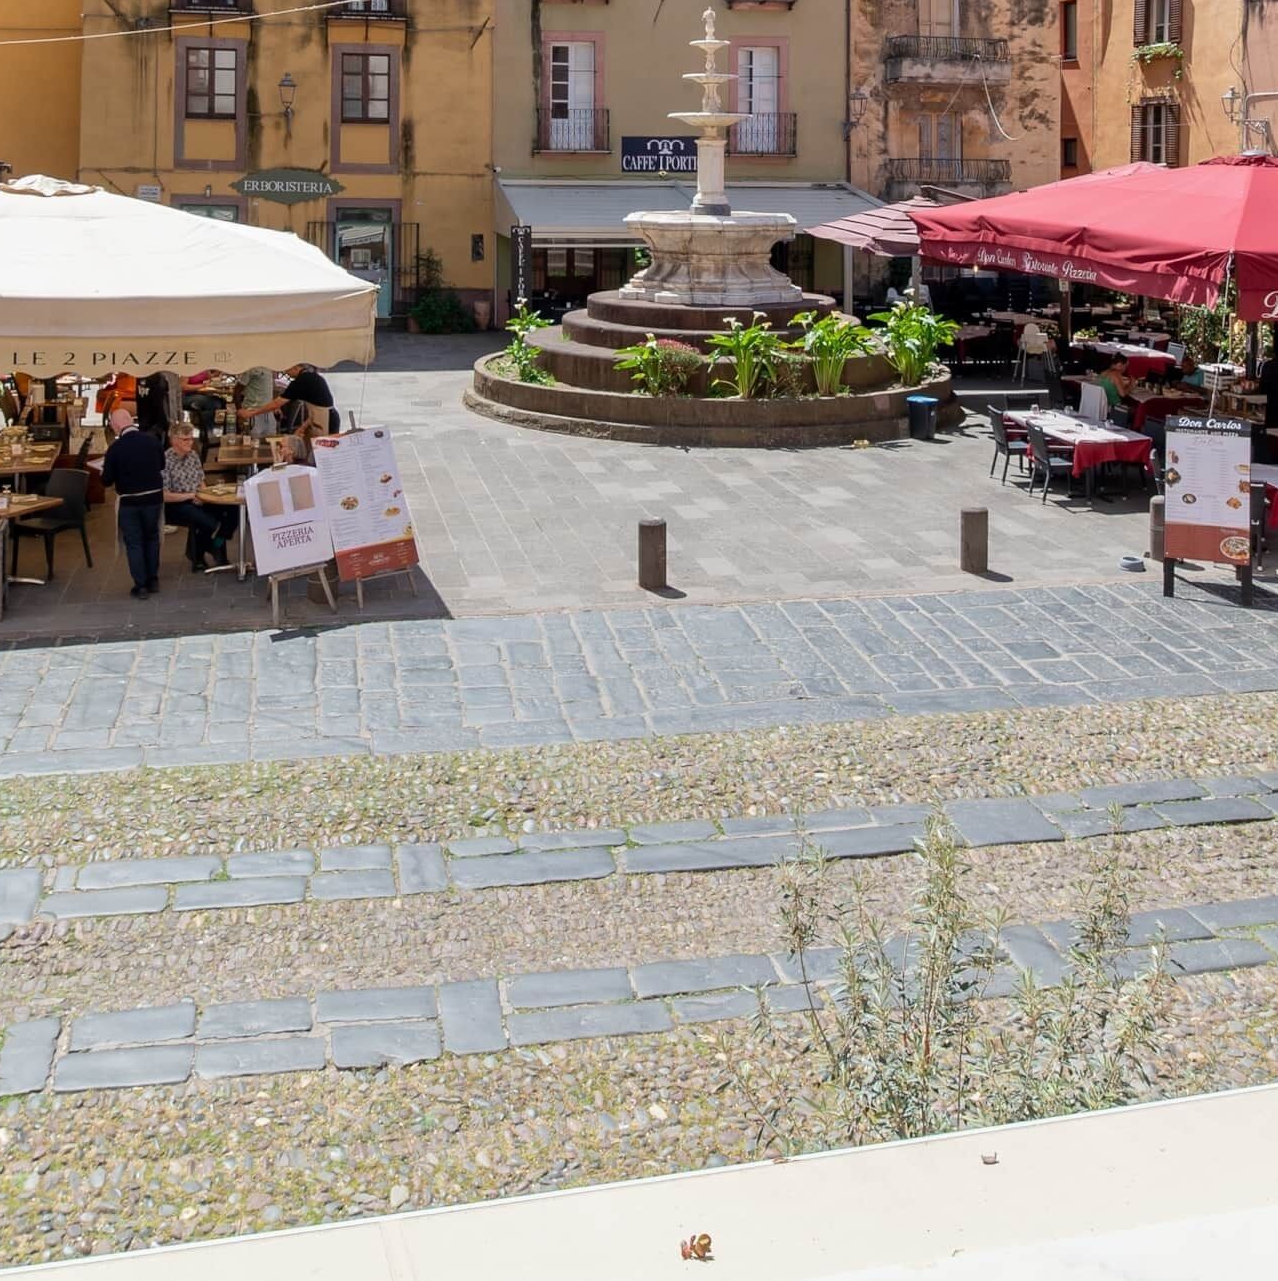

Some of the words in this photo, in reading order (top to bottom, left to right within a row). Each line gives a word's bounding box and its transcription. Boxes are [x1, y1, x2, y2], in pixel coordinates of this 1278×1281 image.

[623, 155, 658, 170] CAFFE'
[244, 180, 332, 193] ERBORISTERIA
[1062, 260, 1097, 281] Pizzeria
[12, 351, 47, 366] LE
[64, 351, 76, 366] 2
[92, 351, 198, 366] PIAZZE
[1178, 416, 1203, 428] Don
[1206, 418, 1242, 430] Carlos
[272, 526, 314, 542] PIZZERIA
[276, 535, 312, 549] APERTA
